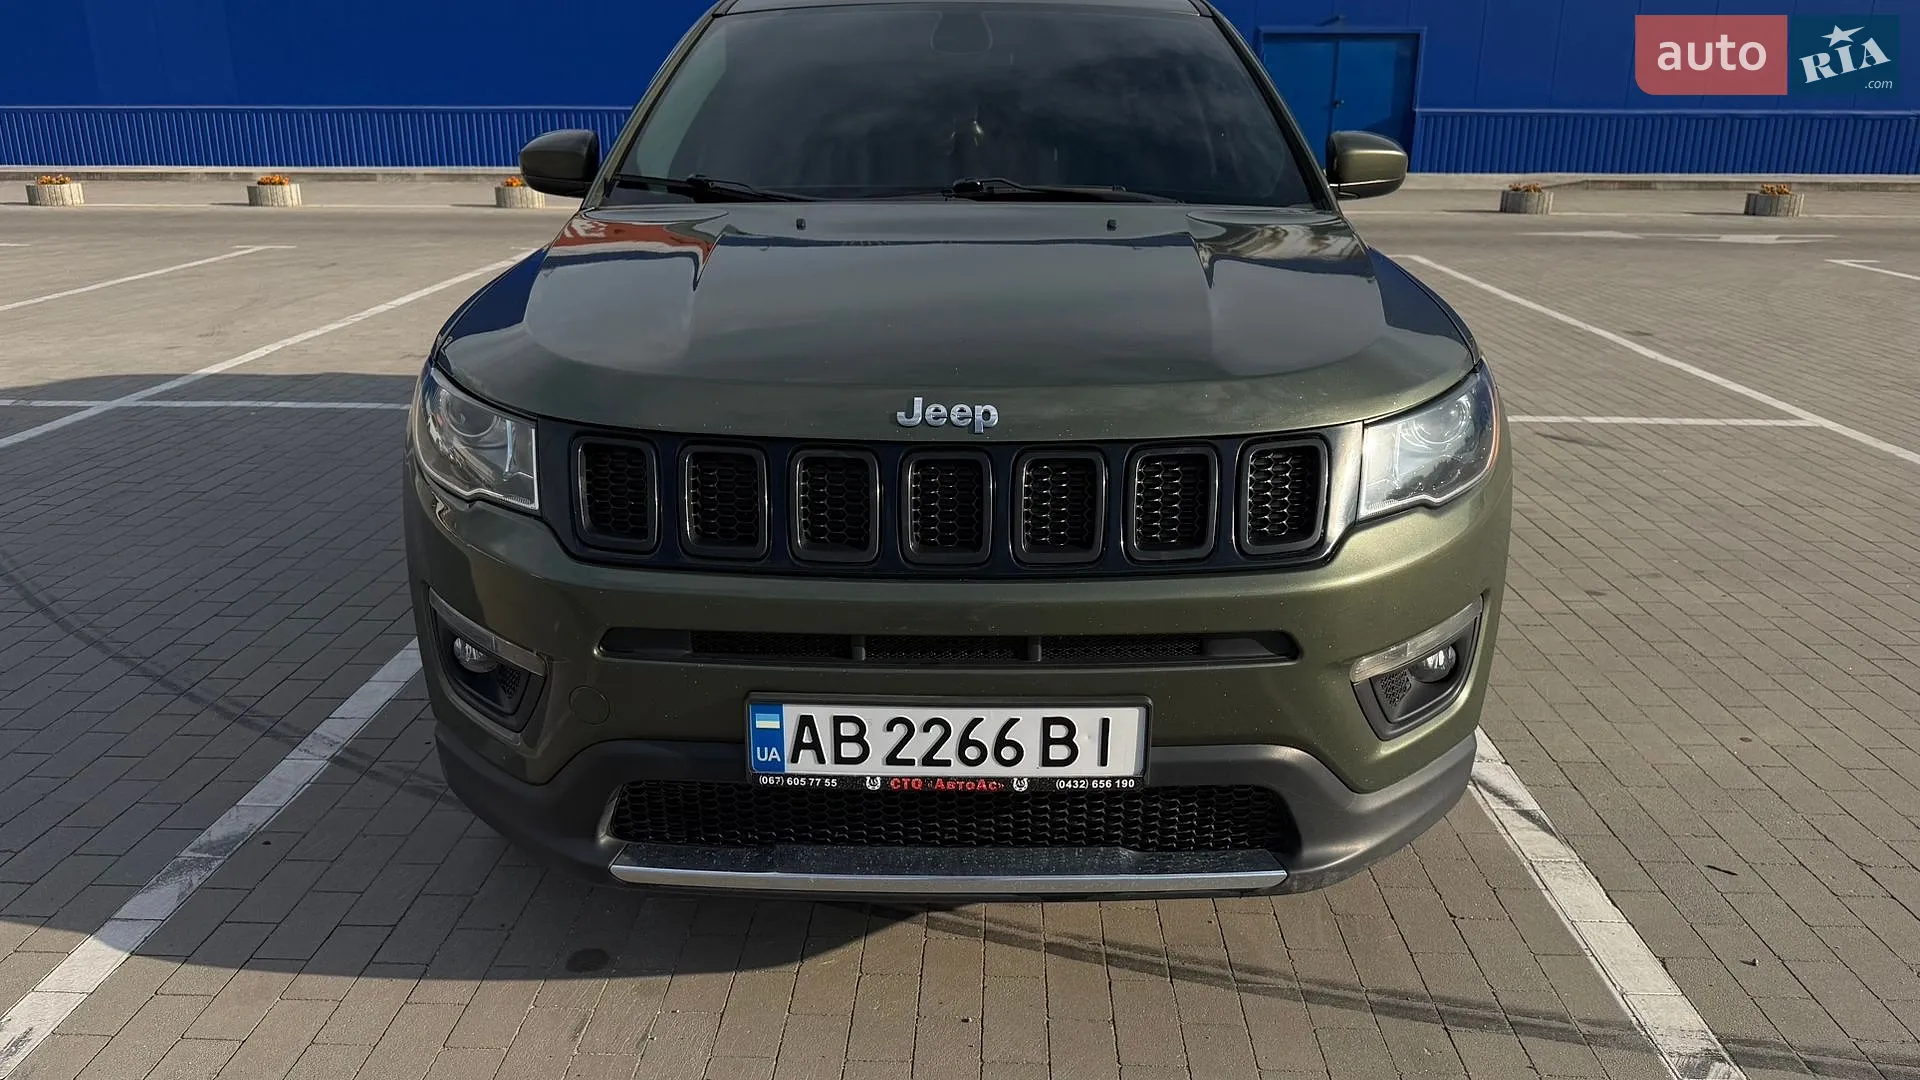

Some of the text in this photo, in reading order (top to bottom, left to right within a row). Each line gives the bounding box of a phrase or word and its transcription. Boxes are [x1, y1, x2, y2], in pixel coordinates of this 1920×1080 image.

[896, 396, 999, 434] Jeep
[789, 714, 871, 766] AB
[882, 717, 1026, 767] 2266
[757, 747, 781, 762] UA
[759, 775, 838, 787] (067) 605 77 55
[1055, 779, 1135, 790] (0432) 656 190
